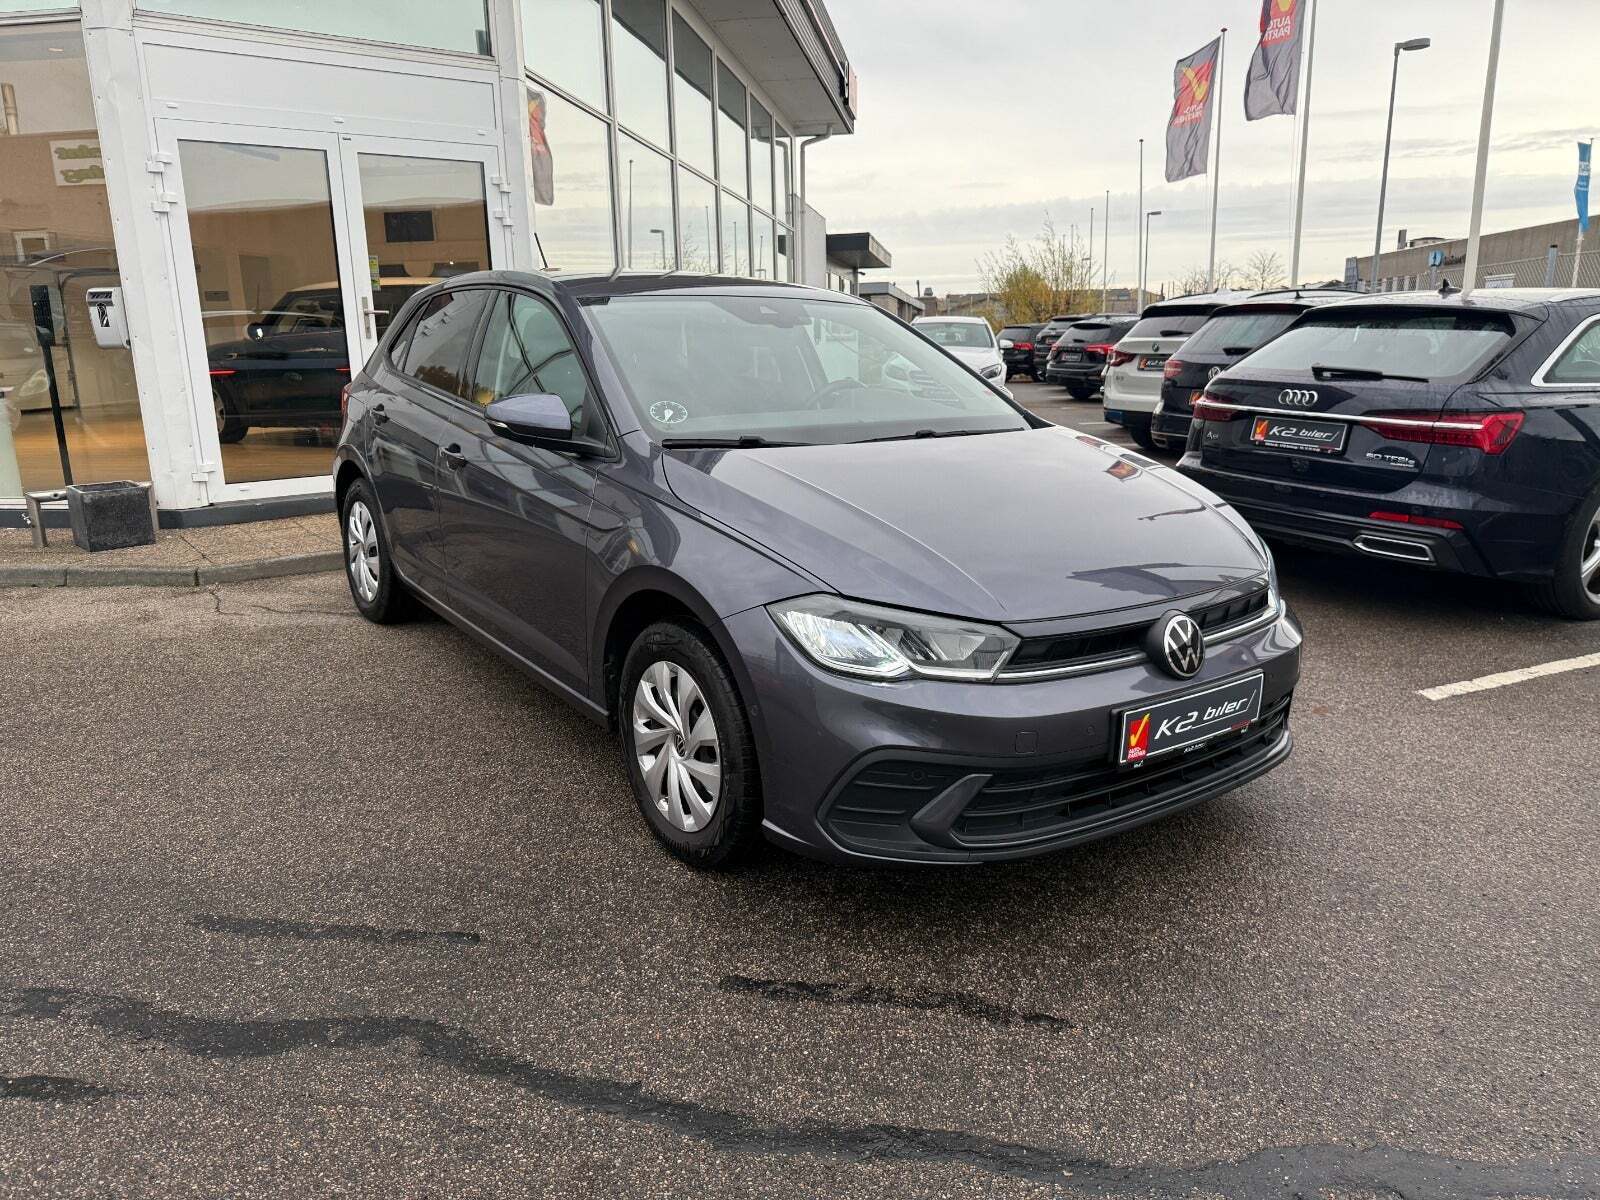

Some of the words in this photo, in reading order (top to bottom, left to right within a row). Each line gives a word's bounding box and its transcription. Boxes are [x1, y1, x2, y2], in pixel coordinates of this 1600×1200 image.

[1269, 425, 1297, 437] K2
[1299, 429, 1333, 438] biler
[1154, 711, 1199, 740] K2
[1203, 698, 1248, 721] biler
